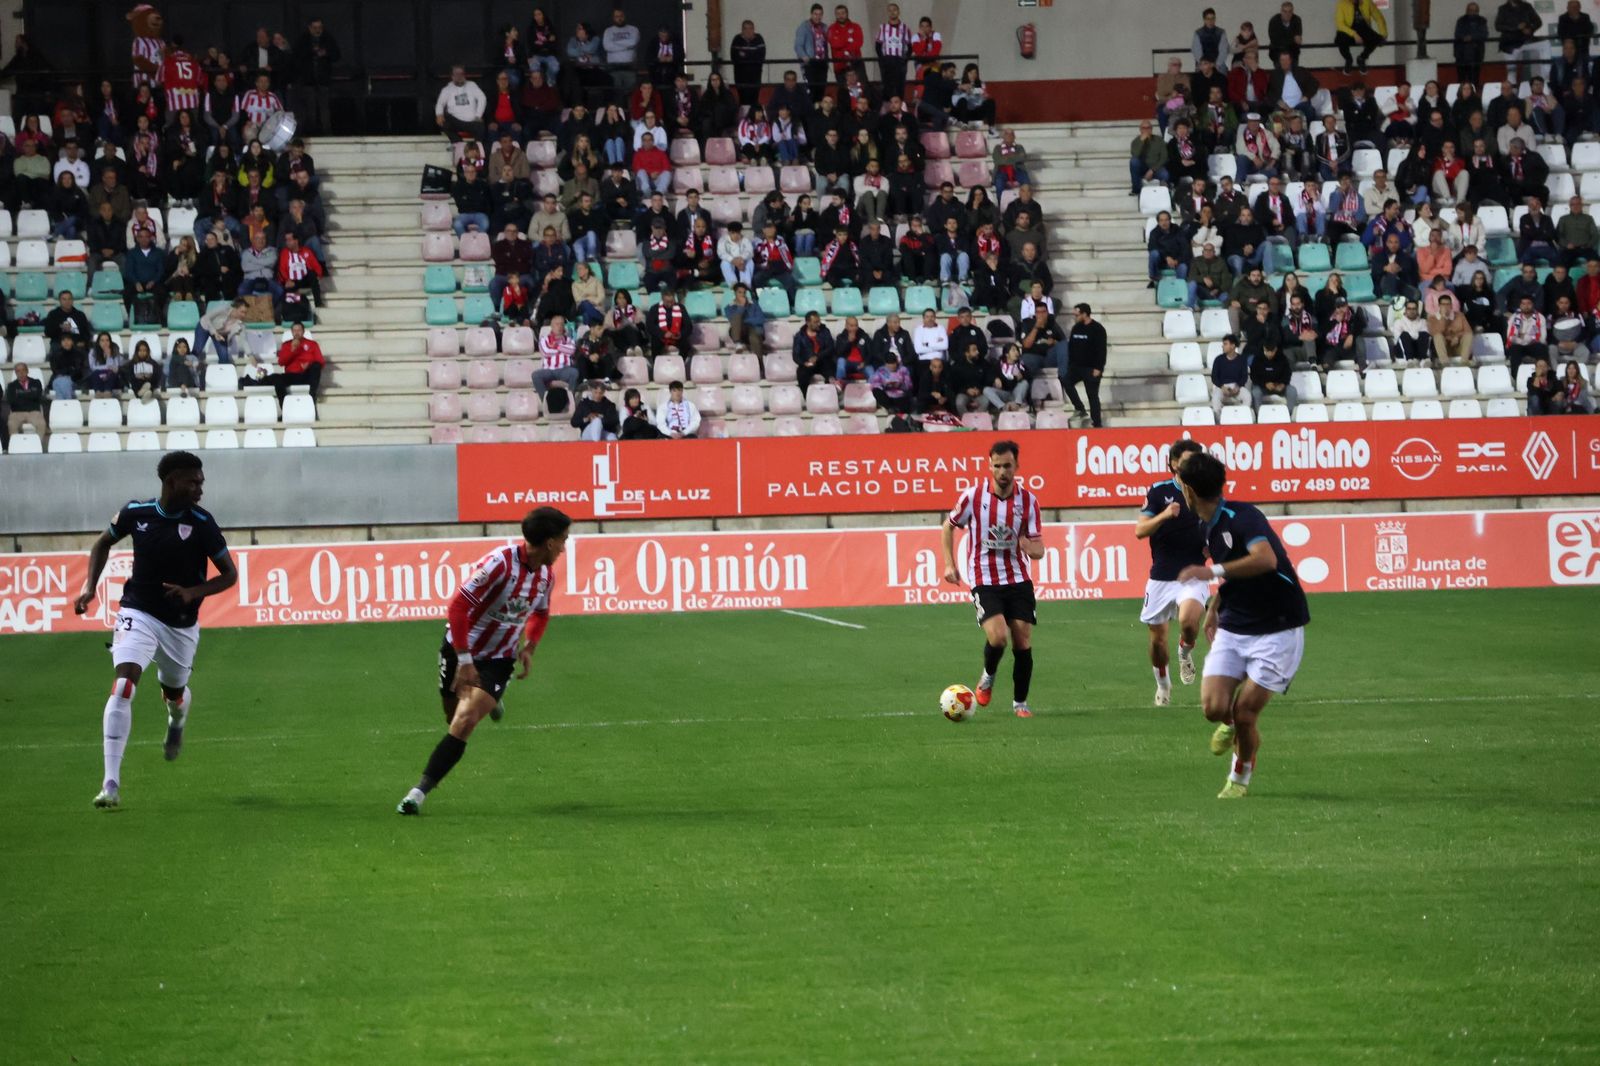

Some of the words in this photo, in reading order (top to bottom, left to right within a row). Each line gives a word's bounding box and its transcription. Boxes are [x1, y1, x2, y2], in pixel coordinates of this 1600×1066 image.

[176, 62, 192, 79] 15
[1076, 431, 1262, 476] Saneantos
[1272, 427, 1370, 469] Atilano
[1391, 454, 1441, 464] NISSAN
[810, 457, 990, 476] RESTAURANT
[1456, 464, 1507, 472] DACIA
[769, 481, 880, 497] PALACIO
[894, 479, 942, 493] DEL
[956, 476, 1044, 491] DRO
[1078, 486, 1111, 498] Pza.
[1116, 484, 1150, 497] Cua
[1271, 480, 1300, 492] 607
[1306, 479, 1335, 491] 489
[1341, 478, 1369, 490] 002
[486, 493, 508, 504] LA
[515, 489, 589, 503] FÁBRICA
[623, 490, 644, 502] DE
[650, 490, 671, 501] LA
[678, 489, 710, 501] LUZ
[886, 533, 940, 588] La
[957, 533, 1129, 586] nión
[1413, 558, 1460, 572] Junta
[1466, 557, 1486, 569] de
[0, 559, 66, 595] CIÓN
[237, 551, 293, 607] La
[565, 539, 619, 596] La
[636, 540, 808, 612] Opinión
[1367, 575, 1426, 590] Castilla
[1431, 578, 1441, 590] y
[1445, 572, 1487, 587] León
[584, 598, 601, 611] El
[606, 597, 668, 611] Correo
[686, 595, 707, 609] de
[711, 593, 781, 608] Zamora
[905, 590, 922, 603] El
[927, 589, 974, 604] Corre
[1035, 586, 1103, 600] Zamora
[0, 597, 67, 632] ACF
[256, 607, 277, 621] El
[280, 606, 342, 621] Correo
[360, 603, 382, 619] de
[387, 602, 448, 618] Zamor
